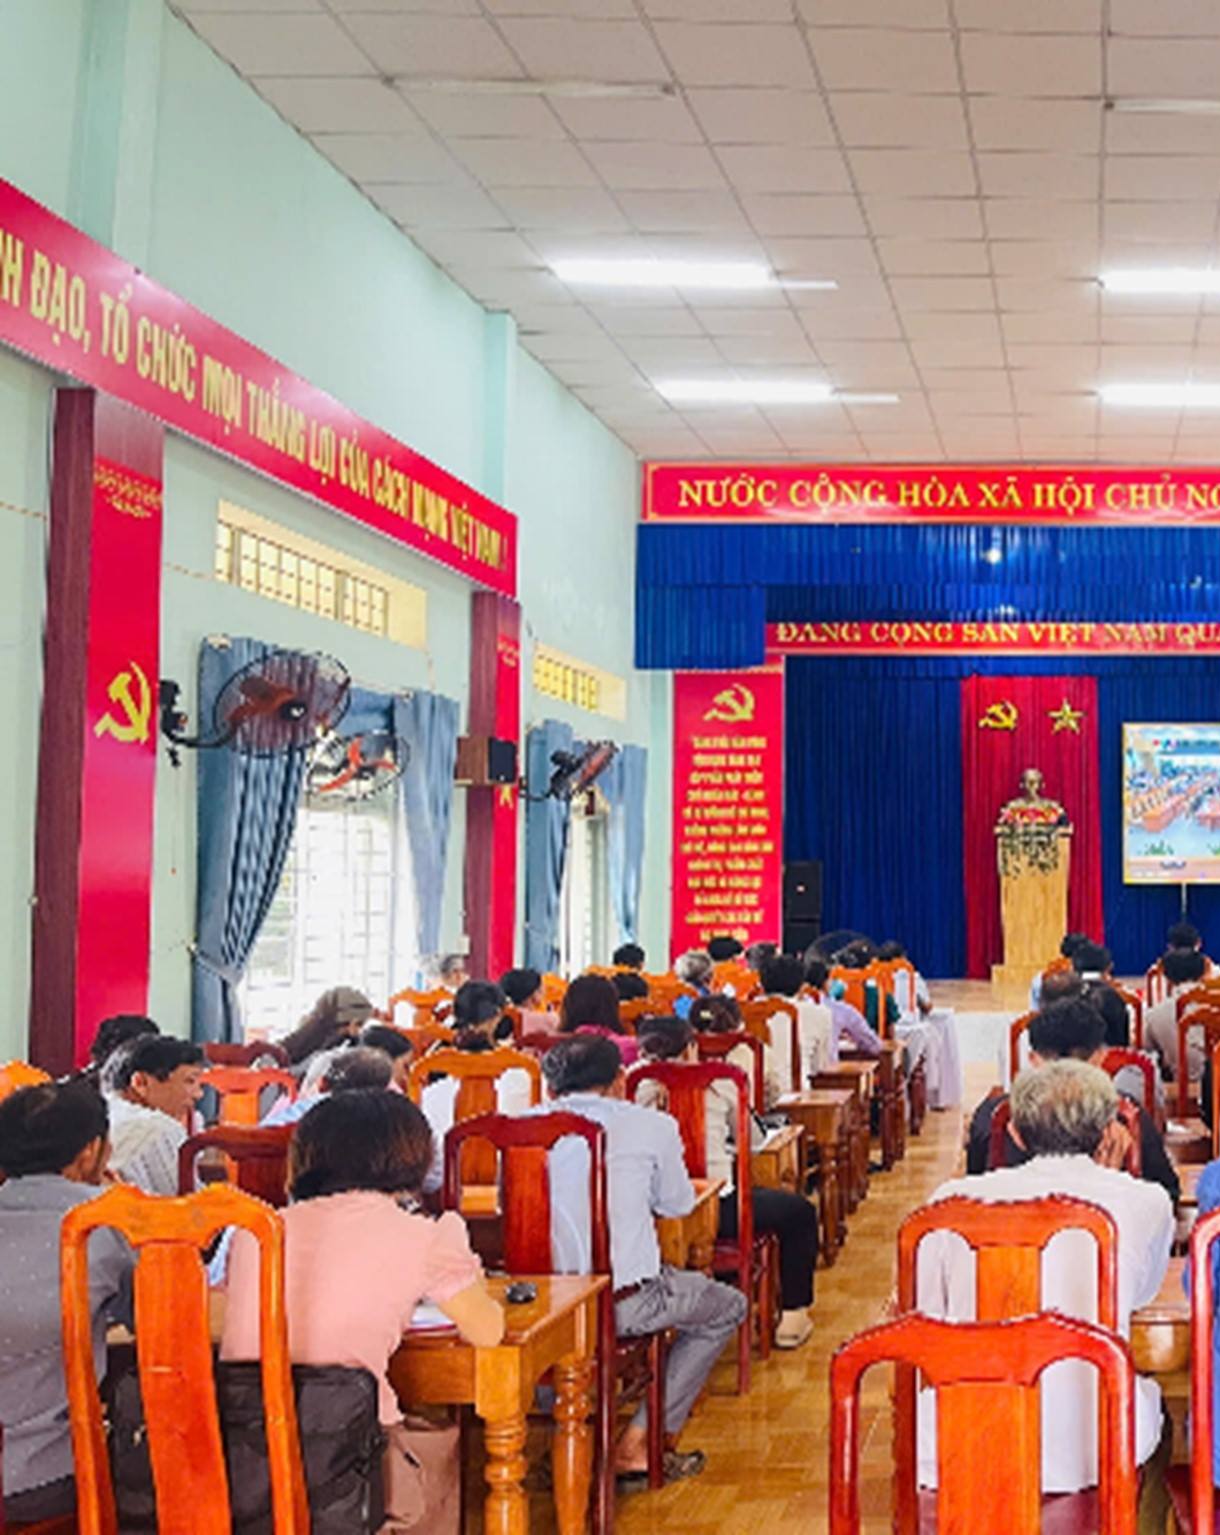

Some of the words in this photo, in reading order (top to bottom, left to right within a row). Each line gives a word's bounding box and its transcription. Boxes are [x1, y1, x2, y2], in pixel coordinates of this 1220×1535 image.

[31, 250, 91, 354] ĐẠO,
[101, 282, 130, 364] TỔ
[137, 315, 196, 403] CHỨC
[202, 354, 242, 436] MỌI
[678, 472, 778, 508] NƯỚC
[788, 472, 888, 515] CỘNG
[898, 475, 971, 508] HÒA
[978, 475, 1023, 508] XÃ
[1032, 475, 1096, 517] HỘI
[1104, 473, 1178, 512] CHỦ
[1103, 622, 1167, 643] NAM
